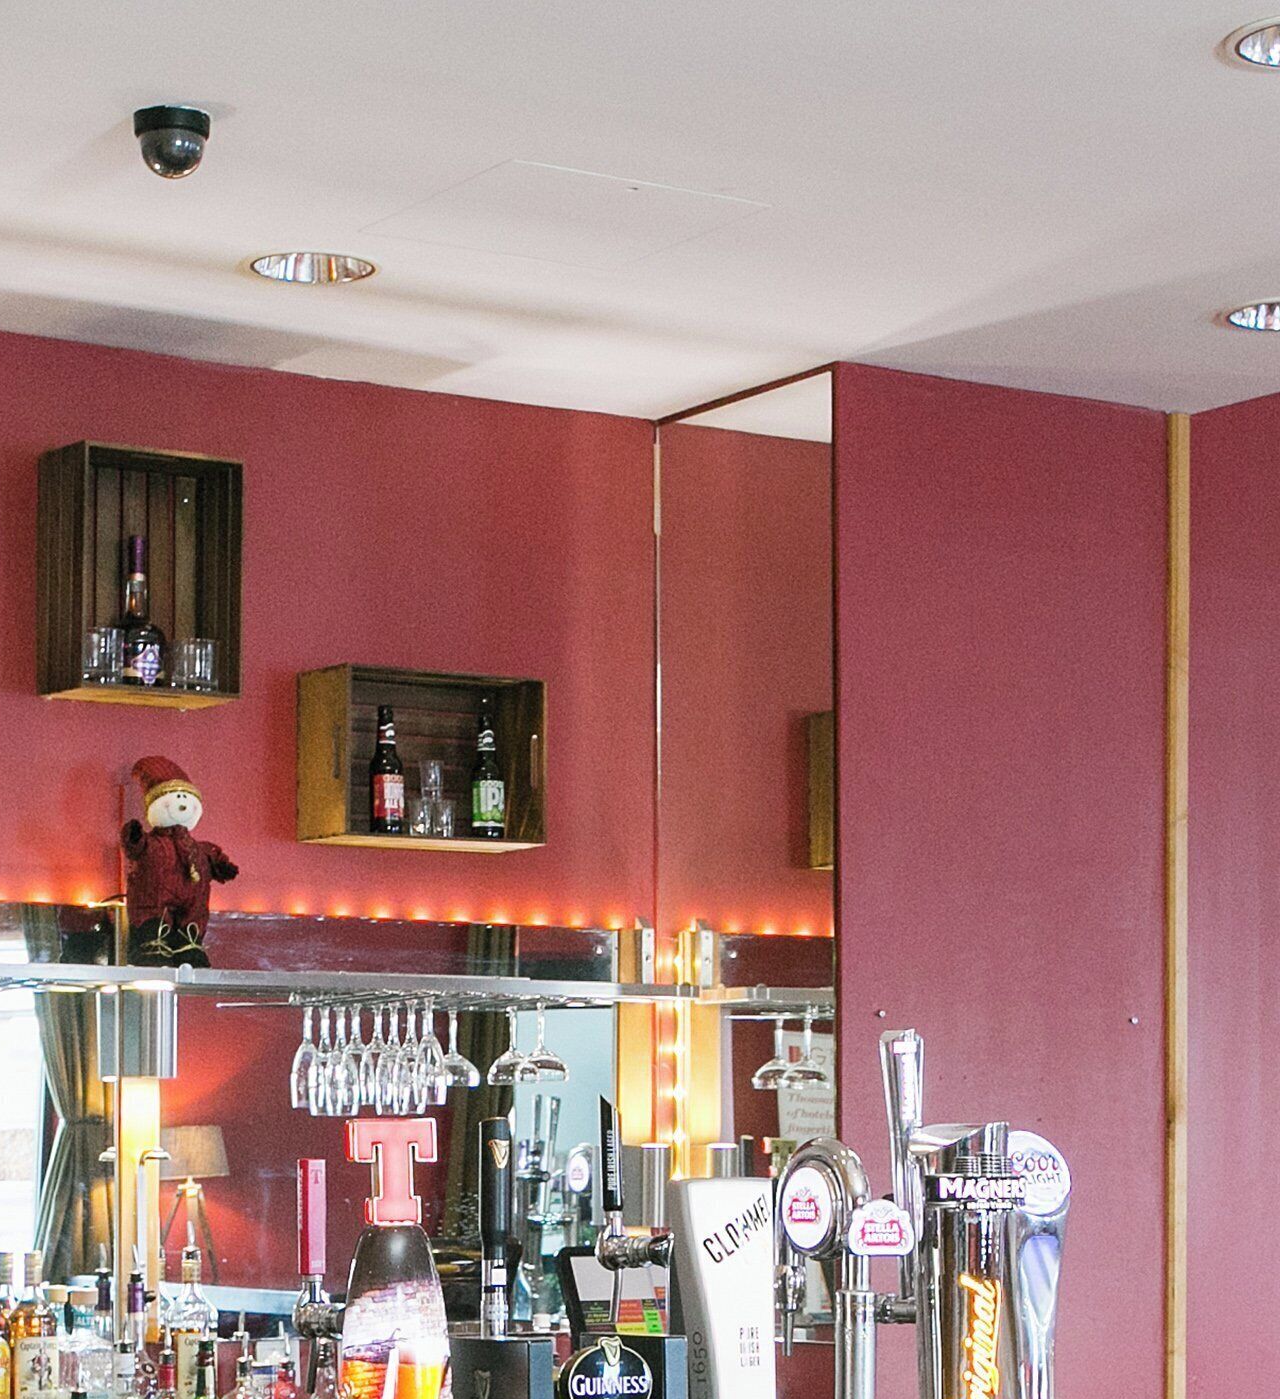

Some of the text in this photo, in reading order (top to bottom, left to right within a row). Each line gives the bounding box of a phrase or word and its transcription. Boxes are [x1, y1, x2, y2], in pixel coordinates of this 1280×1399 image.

[345, 1117, 437, 1226] T
[937, 1176, 1028, 1200] MAGNERS
[862, 1232, 900, 1243] ARTOIS
[864, 1222, 899, 1233] STELLA
[692, 1331, 708, 1385] 1650
[571, 1374, 648, 1397] GUINNESS
